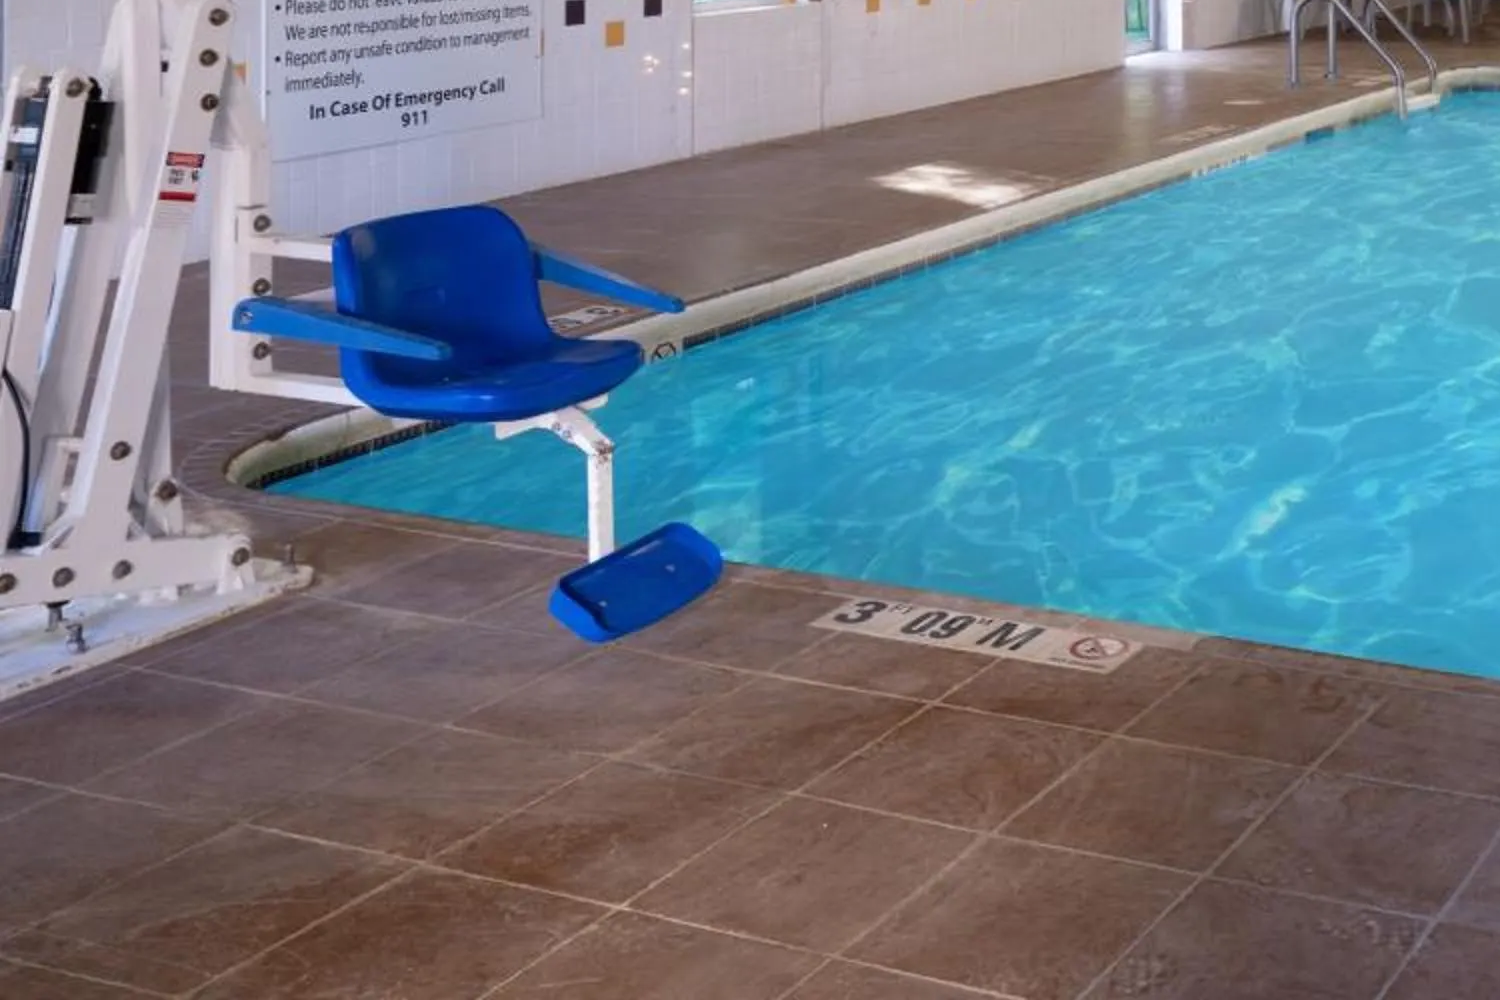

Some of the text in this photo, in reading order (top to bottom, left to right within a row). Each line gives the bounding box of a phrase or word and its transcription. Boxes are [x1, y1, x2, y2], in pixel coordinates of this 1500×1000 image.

[284, 24, 306, 41] We
[308, 24, 329, 39] are
[330, 22, 352, 37] not
[353, 12, 420, 35] responsible
[421, 10, 438, 27] for
[285, 26, 530, 71] Report any unsafe condition to management
[285, 68, 365, 93] immediately.
[308, 76, 505, 121] In Case Of Emergency Call
[400, 109, 428, 129] 911
[834, 600, 887, 624] 3
[975, 621, 1045, 651] M
